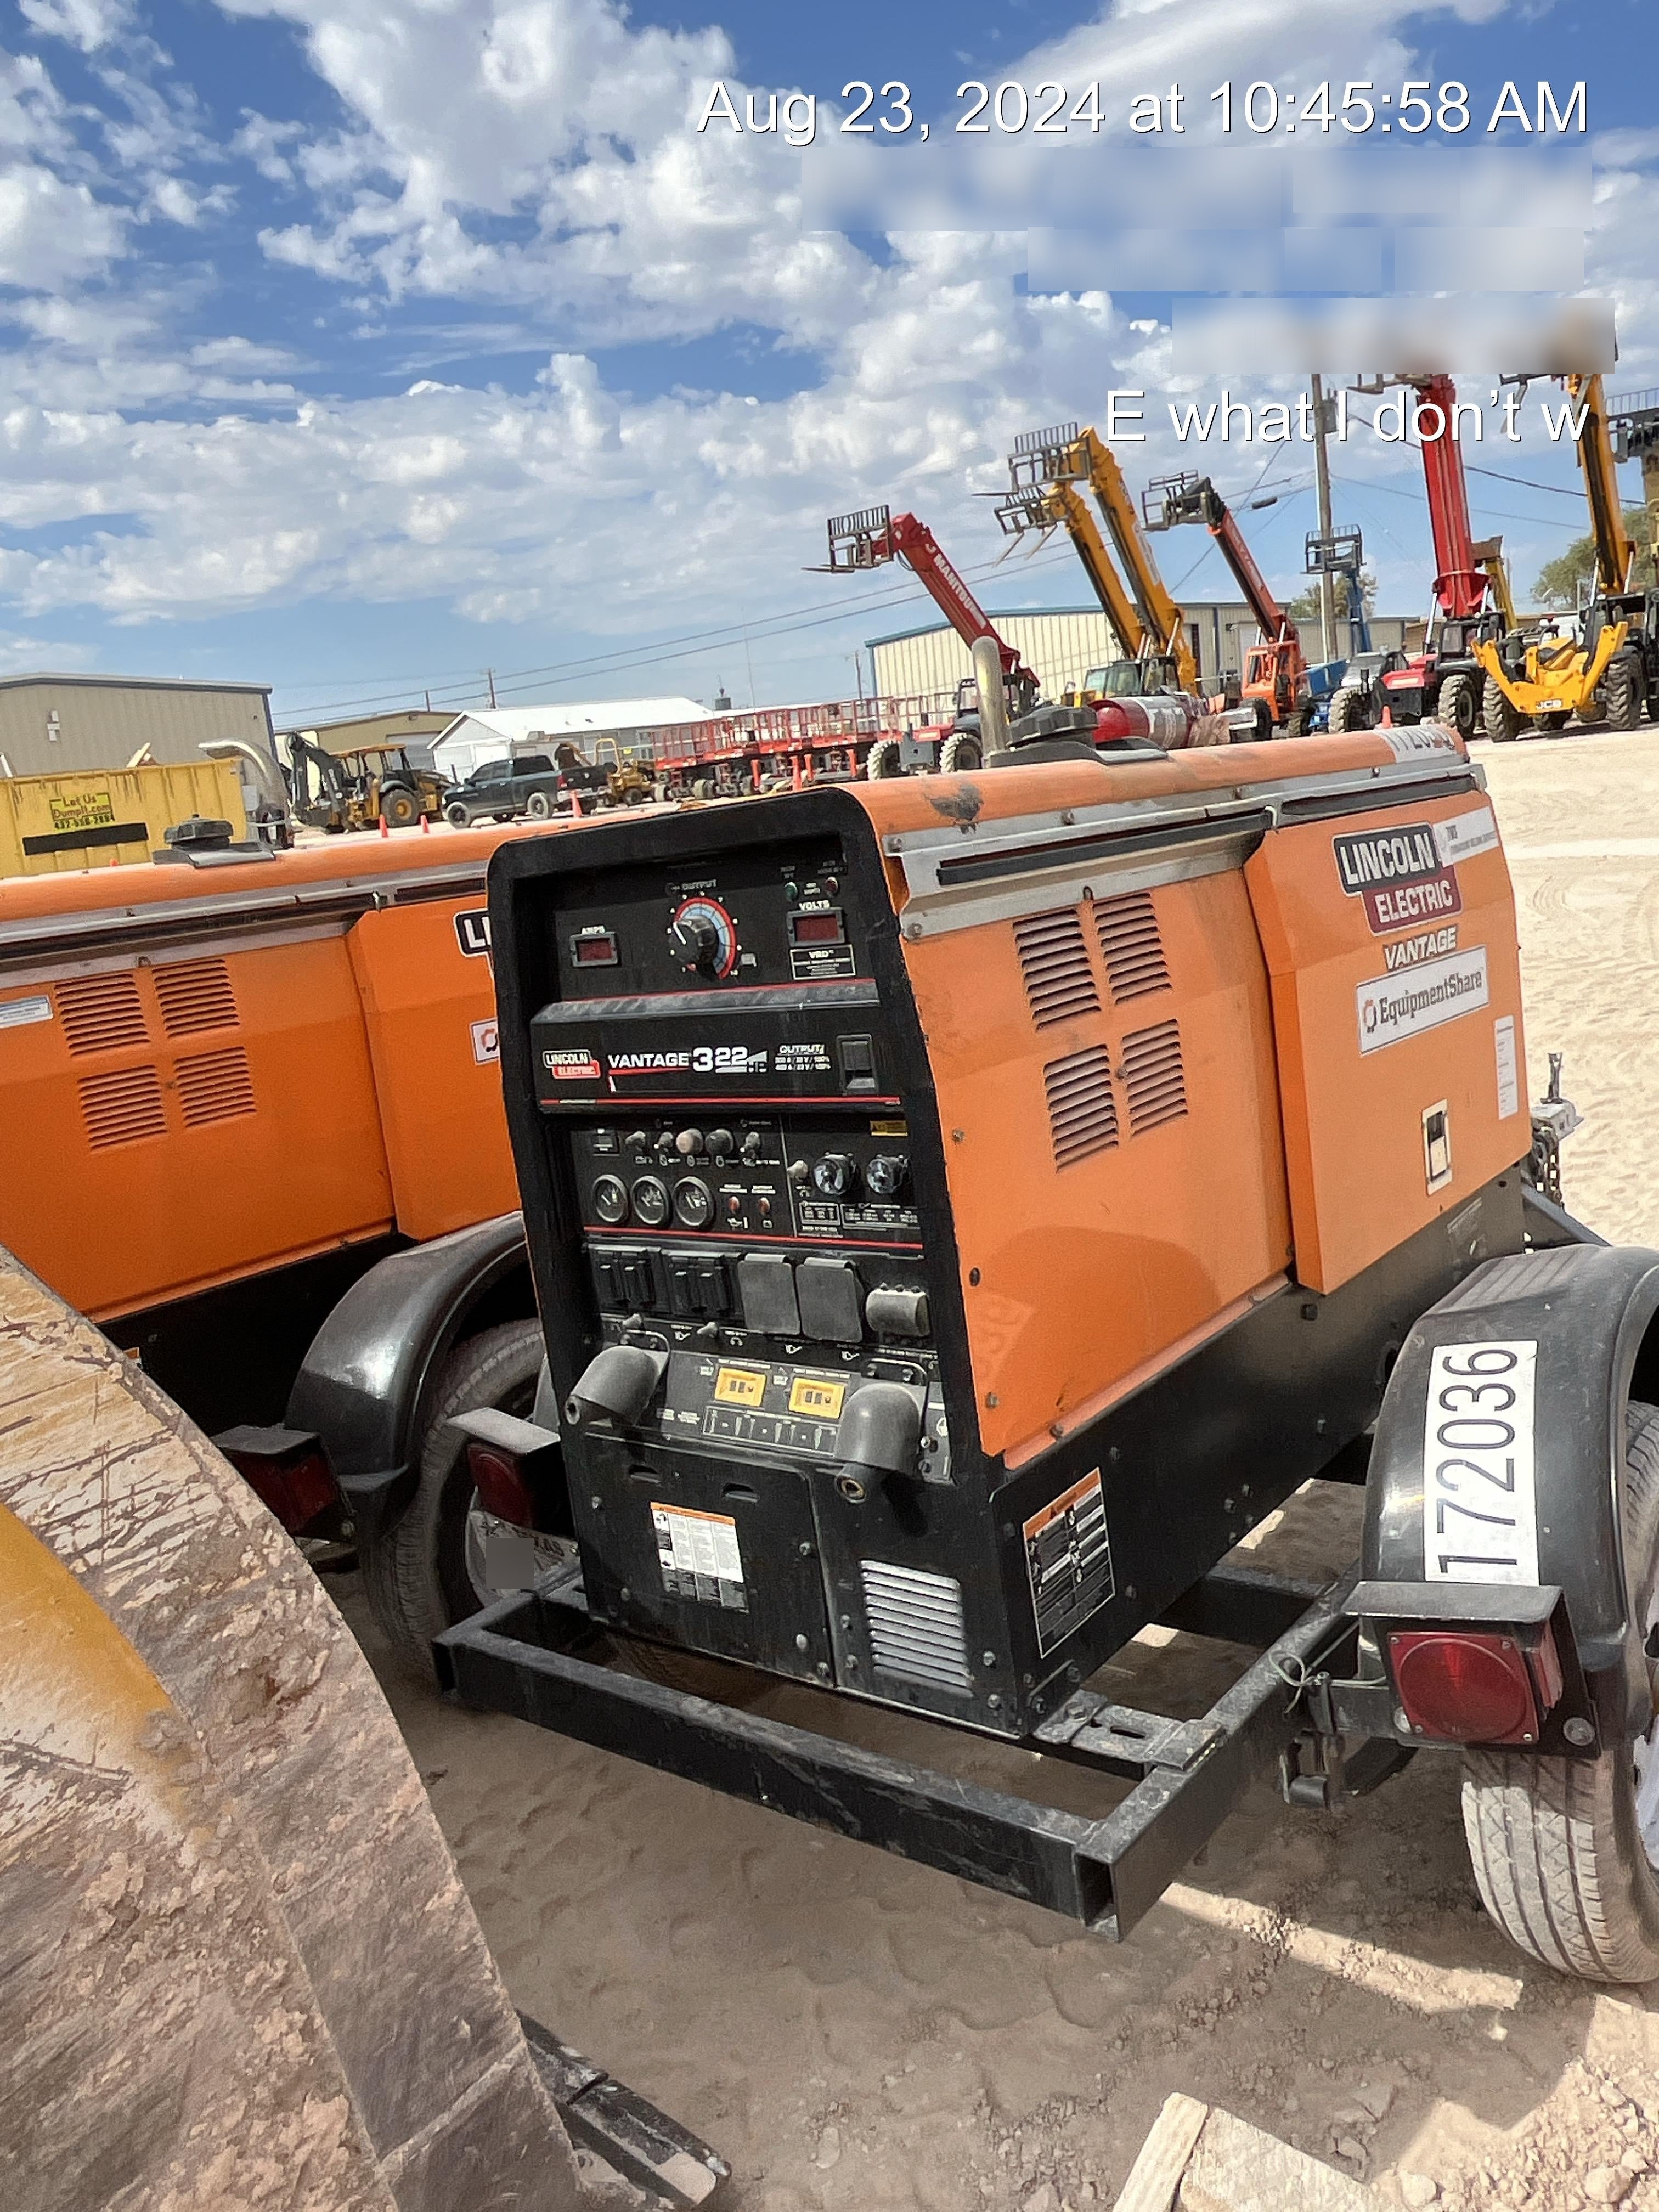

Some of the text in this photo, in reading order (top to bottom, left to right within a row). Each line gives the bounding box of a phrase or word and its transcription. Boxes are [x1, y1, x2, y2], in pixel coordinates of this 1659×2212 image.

[934, 554, 973, 610] MANITOU
[1536, 699, 1562, 710] JCB
[63, 793, 97, 807] Let Us
[1340, 832, 1435, 885] LINCOLN
[798, 899, 831, 911] VOLTS
[1375, 879, 1453, 923] ELECTRIC
[1385, 926, 1457, 969] VANTAGE
[1379, 970, 1481, 1026] EquipmentShare
[545, 1053, 589, 1065] LINCOLN
[558, 1066, 596, 1075] ELECTRIC
[607, 1046, 748, 1072] VANTAGE 322
[1435, 1348, 1518, 1573] 172036
